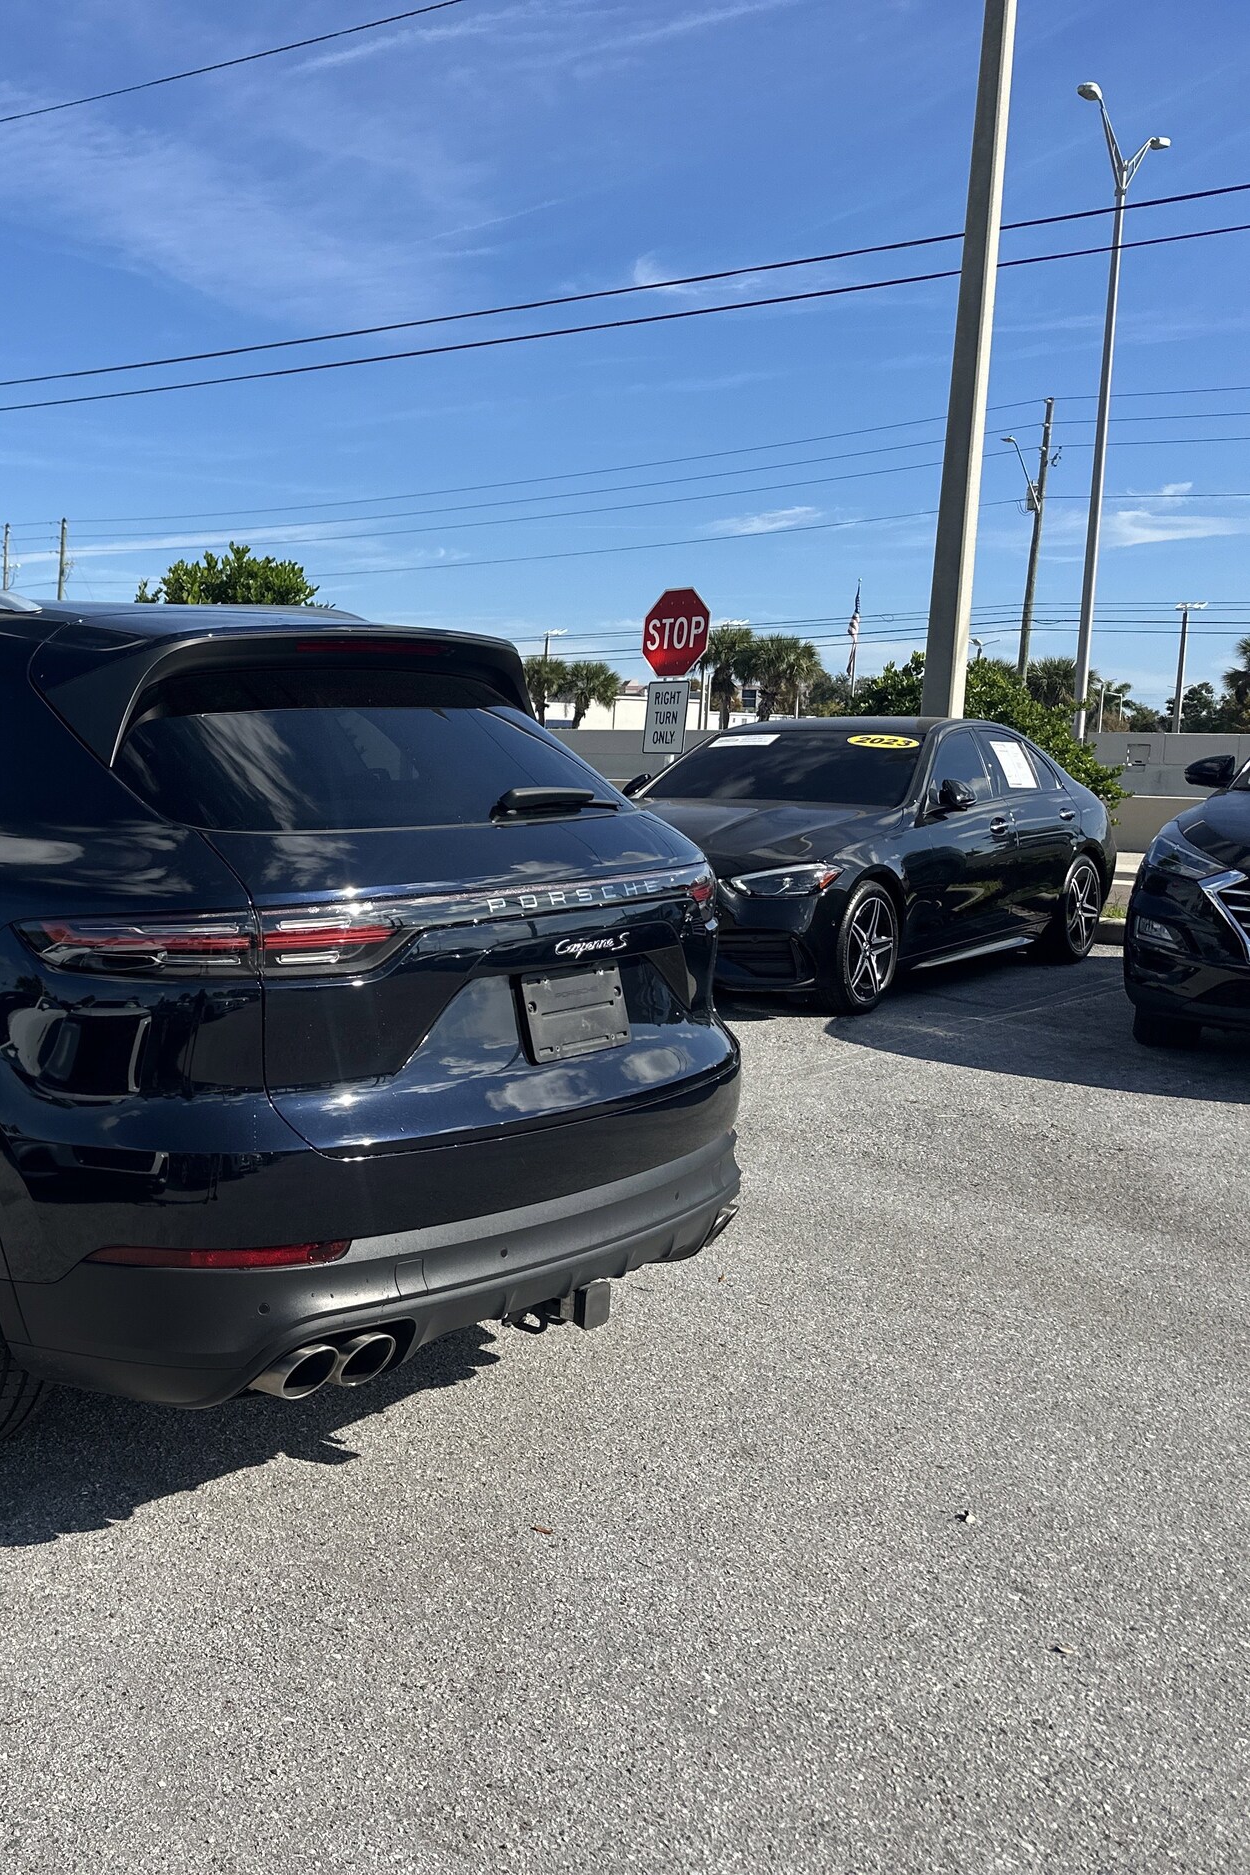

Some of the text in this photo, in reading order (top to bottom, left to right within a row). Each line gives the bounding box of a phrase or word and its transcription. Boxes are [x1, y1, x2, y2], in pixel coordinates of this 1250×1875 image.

[646, 616, 705, 651] STOP
[654, 691, 681, 705] RIGHT
[654, 711, 678, 725] TURN
[652, 731, 675, 745] ONLY
[858, 736, 911, 747] 2023
[486, 880, 660, 913] PORSCHE
[554, 932, 631, 959] Cayenne S
